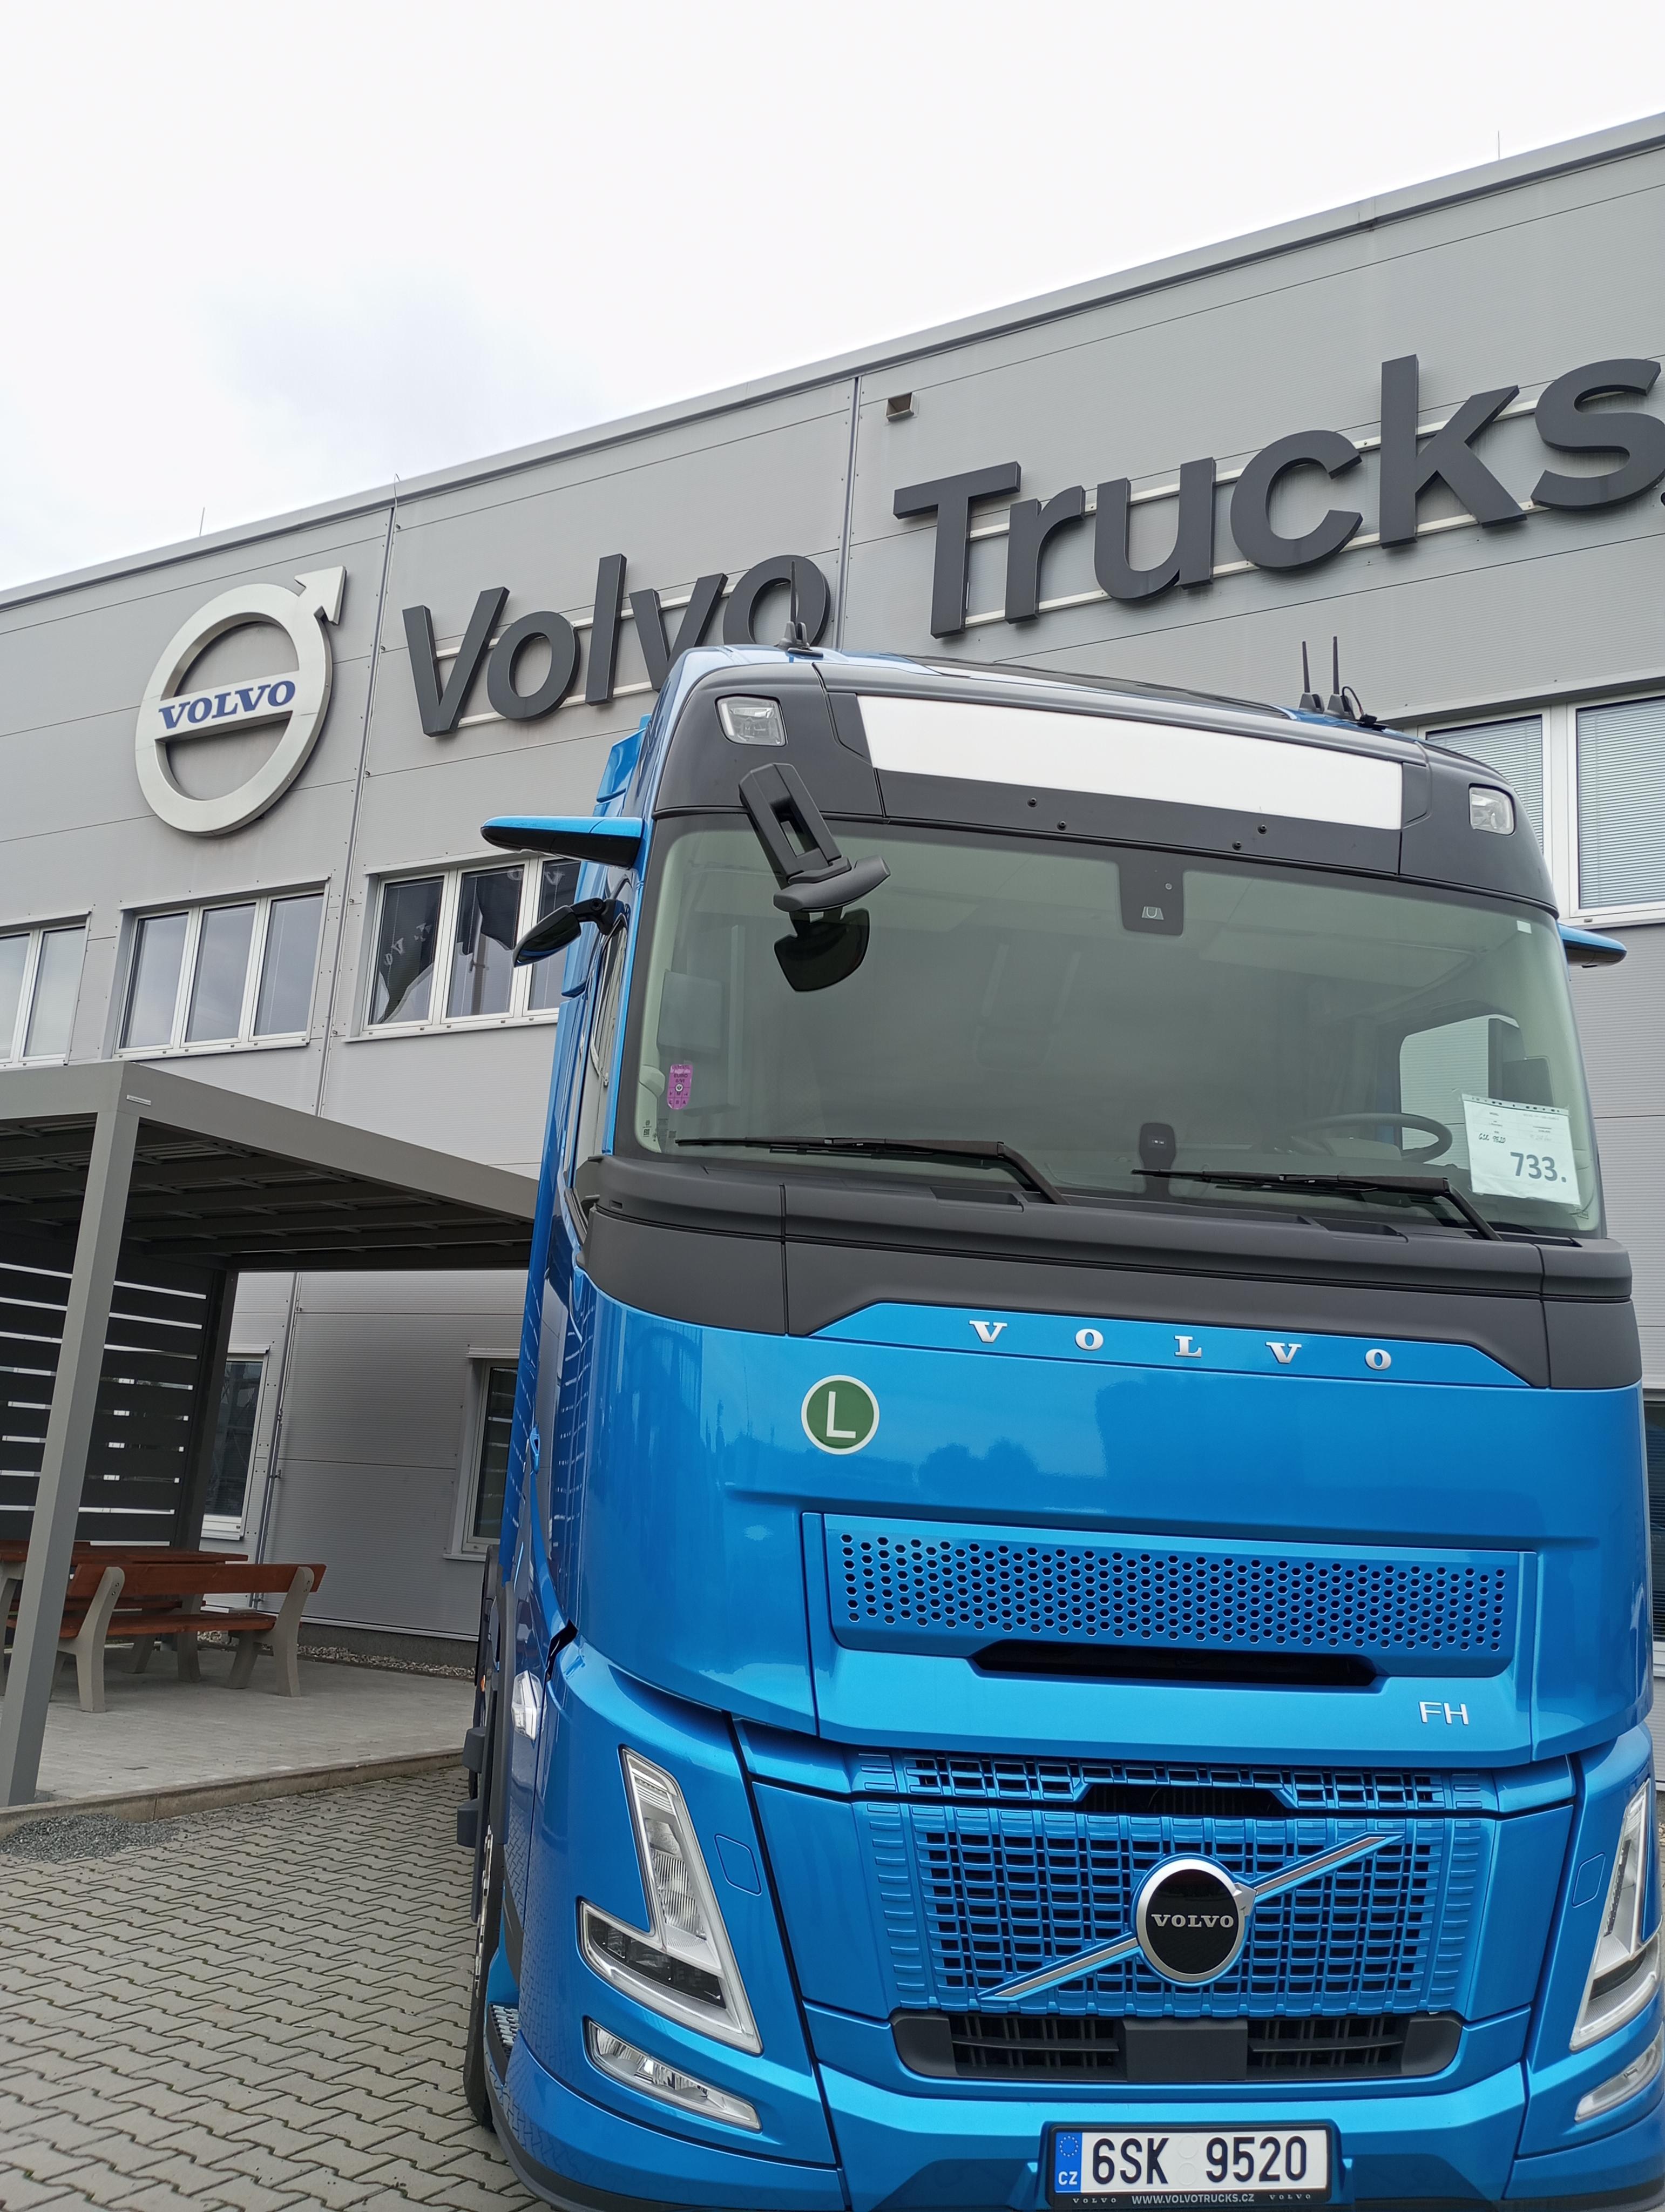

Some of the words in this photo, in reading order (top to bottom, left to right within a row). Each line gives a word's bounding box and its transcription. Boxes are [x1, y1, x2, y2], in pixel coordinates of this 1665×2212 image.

[403, 554, 830, 738] Volvo
[894, 354, 1665, 639] Trucks
[158, 680, 296, 730] VOLVO
[1510, 1151, 1567, 1183] 733.
[969, 1320, 1392, 1371] VOLVO
[826, 1391, 857, 1439] L
[1418, 1701, 1469, 1725] FH
[1151, 1913, 1235, 1928] VOLVO
[1058, 2170, 1079, 2186] CZ
[1092, 2137, 1170, 2185] 6SK
[1206, 2135, 1308, 2183] 9520
[1132, 2193, 1255, 2204] WWW.VOLVOTRUCKS.CZ
